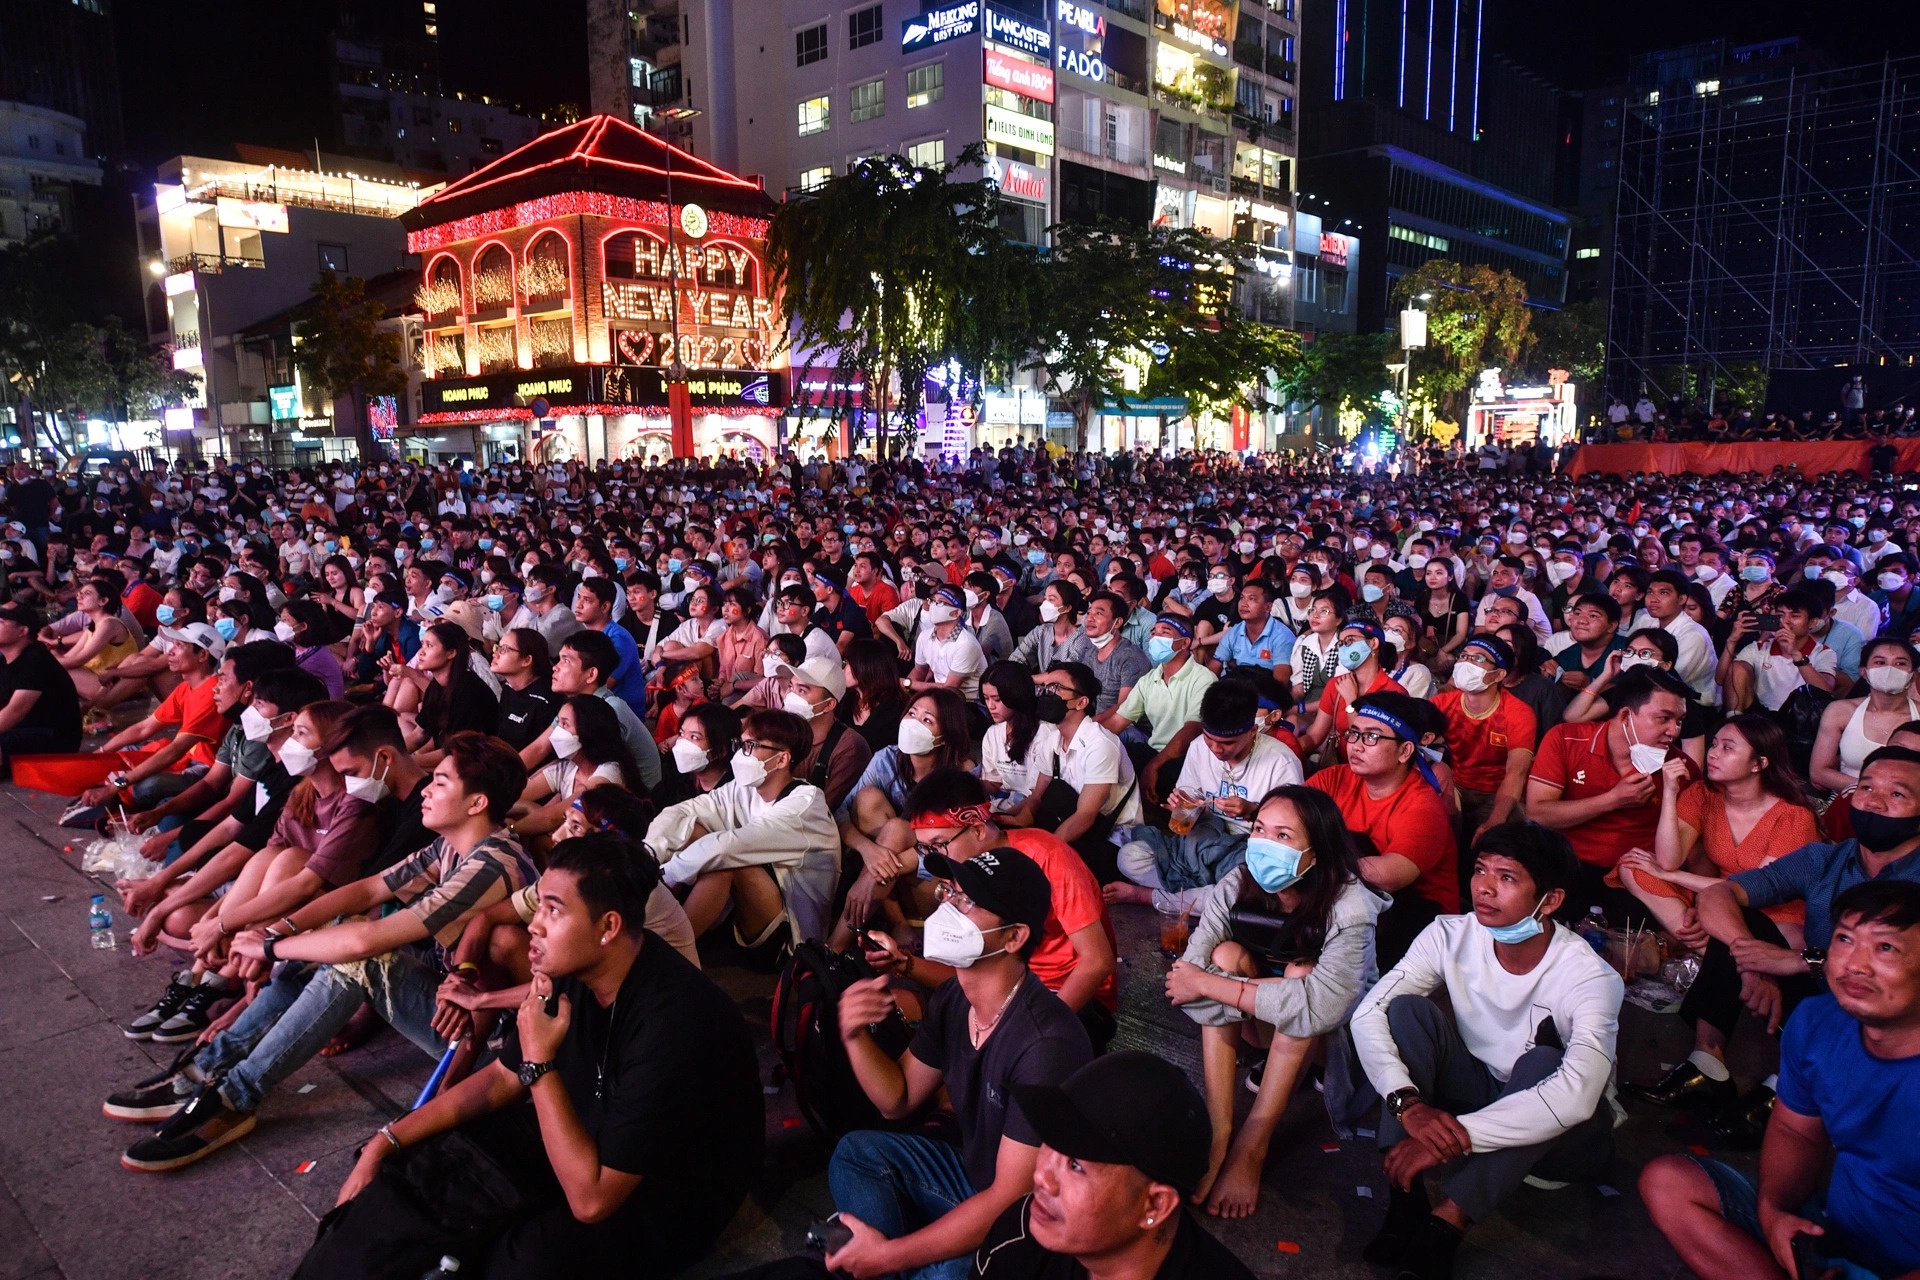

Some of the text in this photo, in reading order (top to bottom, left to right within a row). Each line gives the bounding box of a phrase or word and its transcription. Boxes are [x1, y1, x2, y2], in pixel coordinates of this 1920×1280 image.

[928, 2, 978, 29] MEKONG
[954, 22, 973, 37] STOP
[993, 14, 1050, 48] LANCASTER
[987, 58, 1011, 84] Tiếng
[1012, 70, 1031, 86] anh
[1058, 46, 1103, 82] FADO
[999, 121, 1017, 136] IELTS
[1037, 132, 1053, 146] LONG
[634, 237, 749, 285] HAPPY
[602, 281, 774, 330] NEW YEAR
[659, 332, 738, 370] 2022
[442, 386, 489, 402] HOANG PHUC
[518, 379, 572, 396] HOANG PHUC
[661, 380, 742, 395] HNG PHUC
